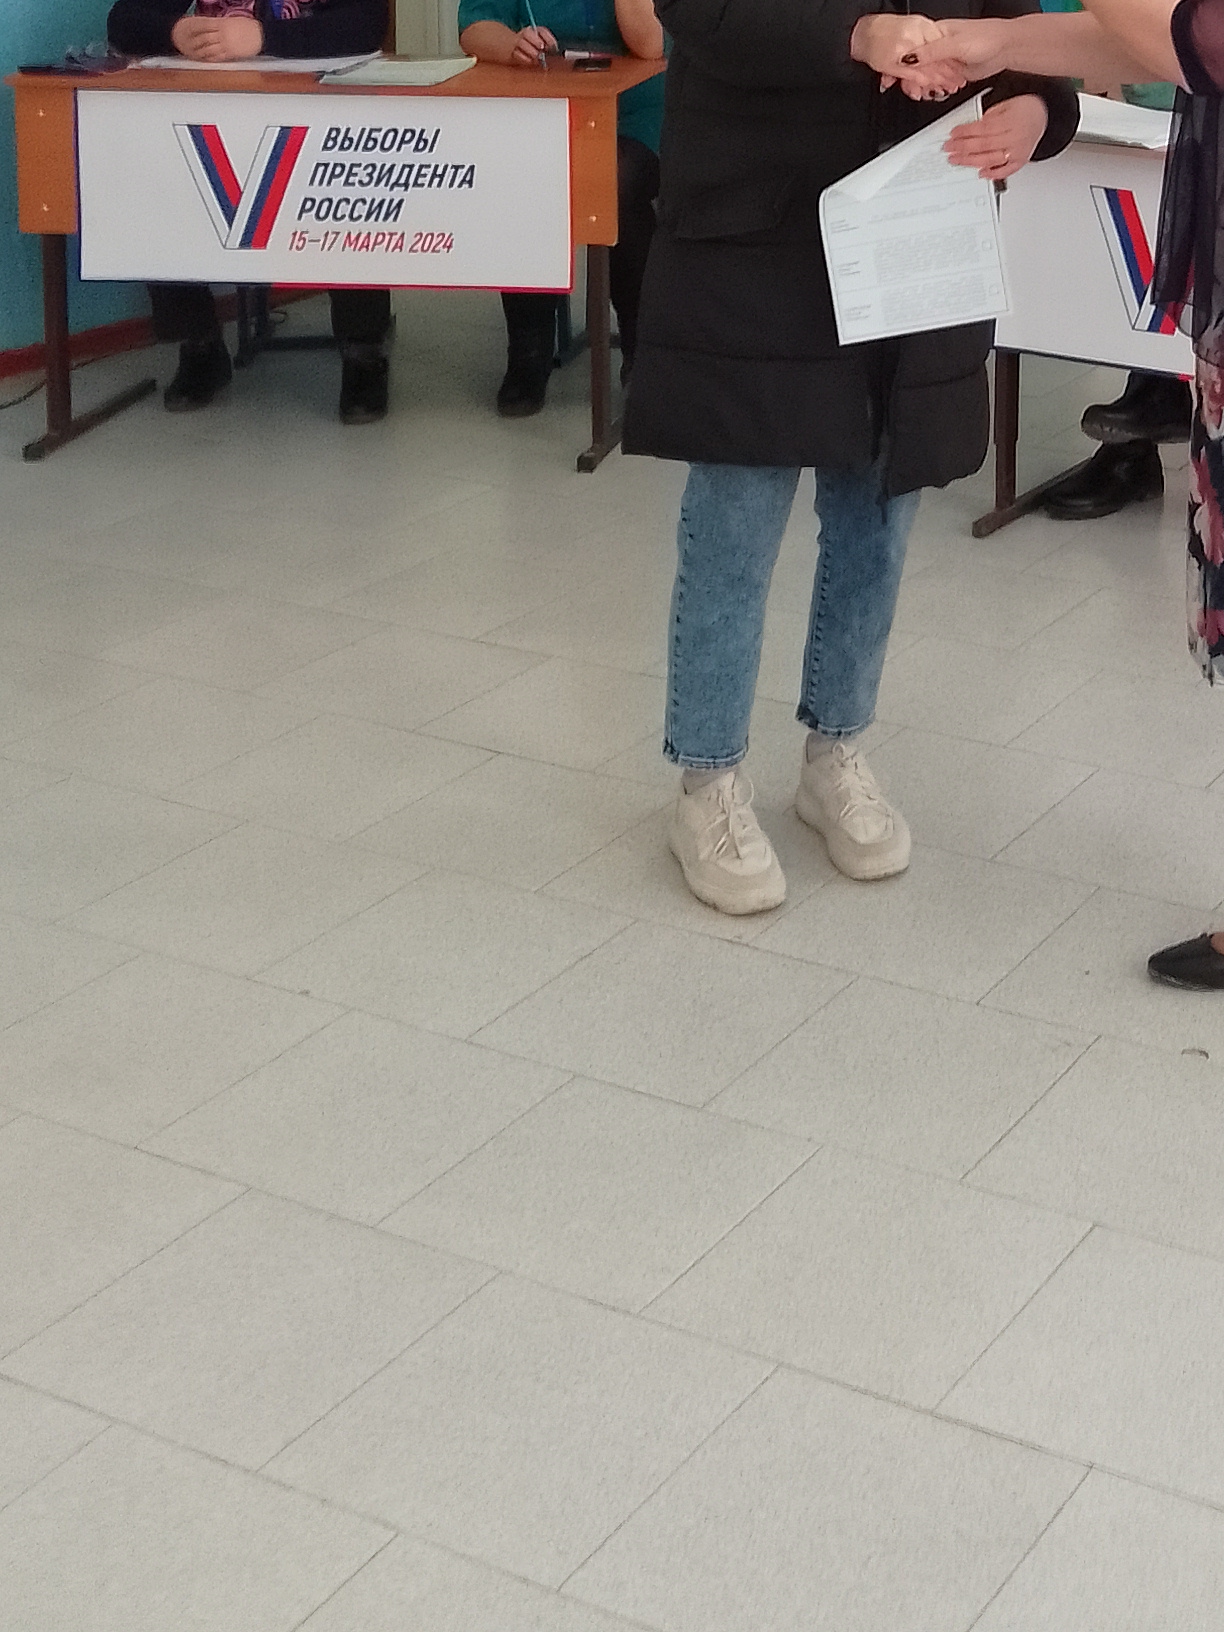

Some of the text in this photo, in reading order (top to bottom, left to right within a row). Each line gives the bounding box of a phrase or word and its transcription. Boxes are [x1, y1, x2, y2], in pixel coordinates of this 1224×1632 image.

[321, 127, 441, 153] ВЫБОРЫ
[308, 162, 476, 192] ПРЕЗИДЕНТА
[297, 197, 405, 222] РОССИИ
[341, 231, 406, 253] МАРТА
[408, 232, 454, 254] 2024
